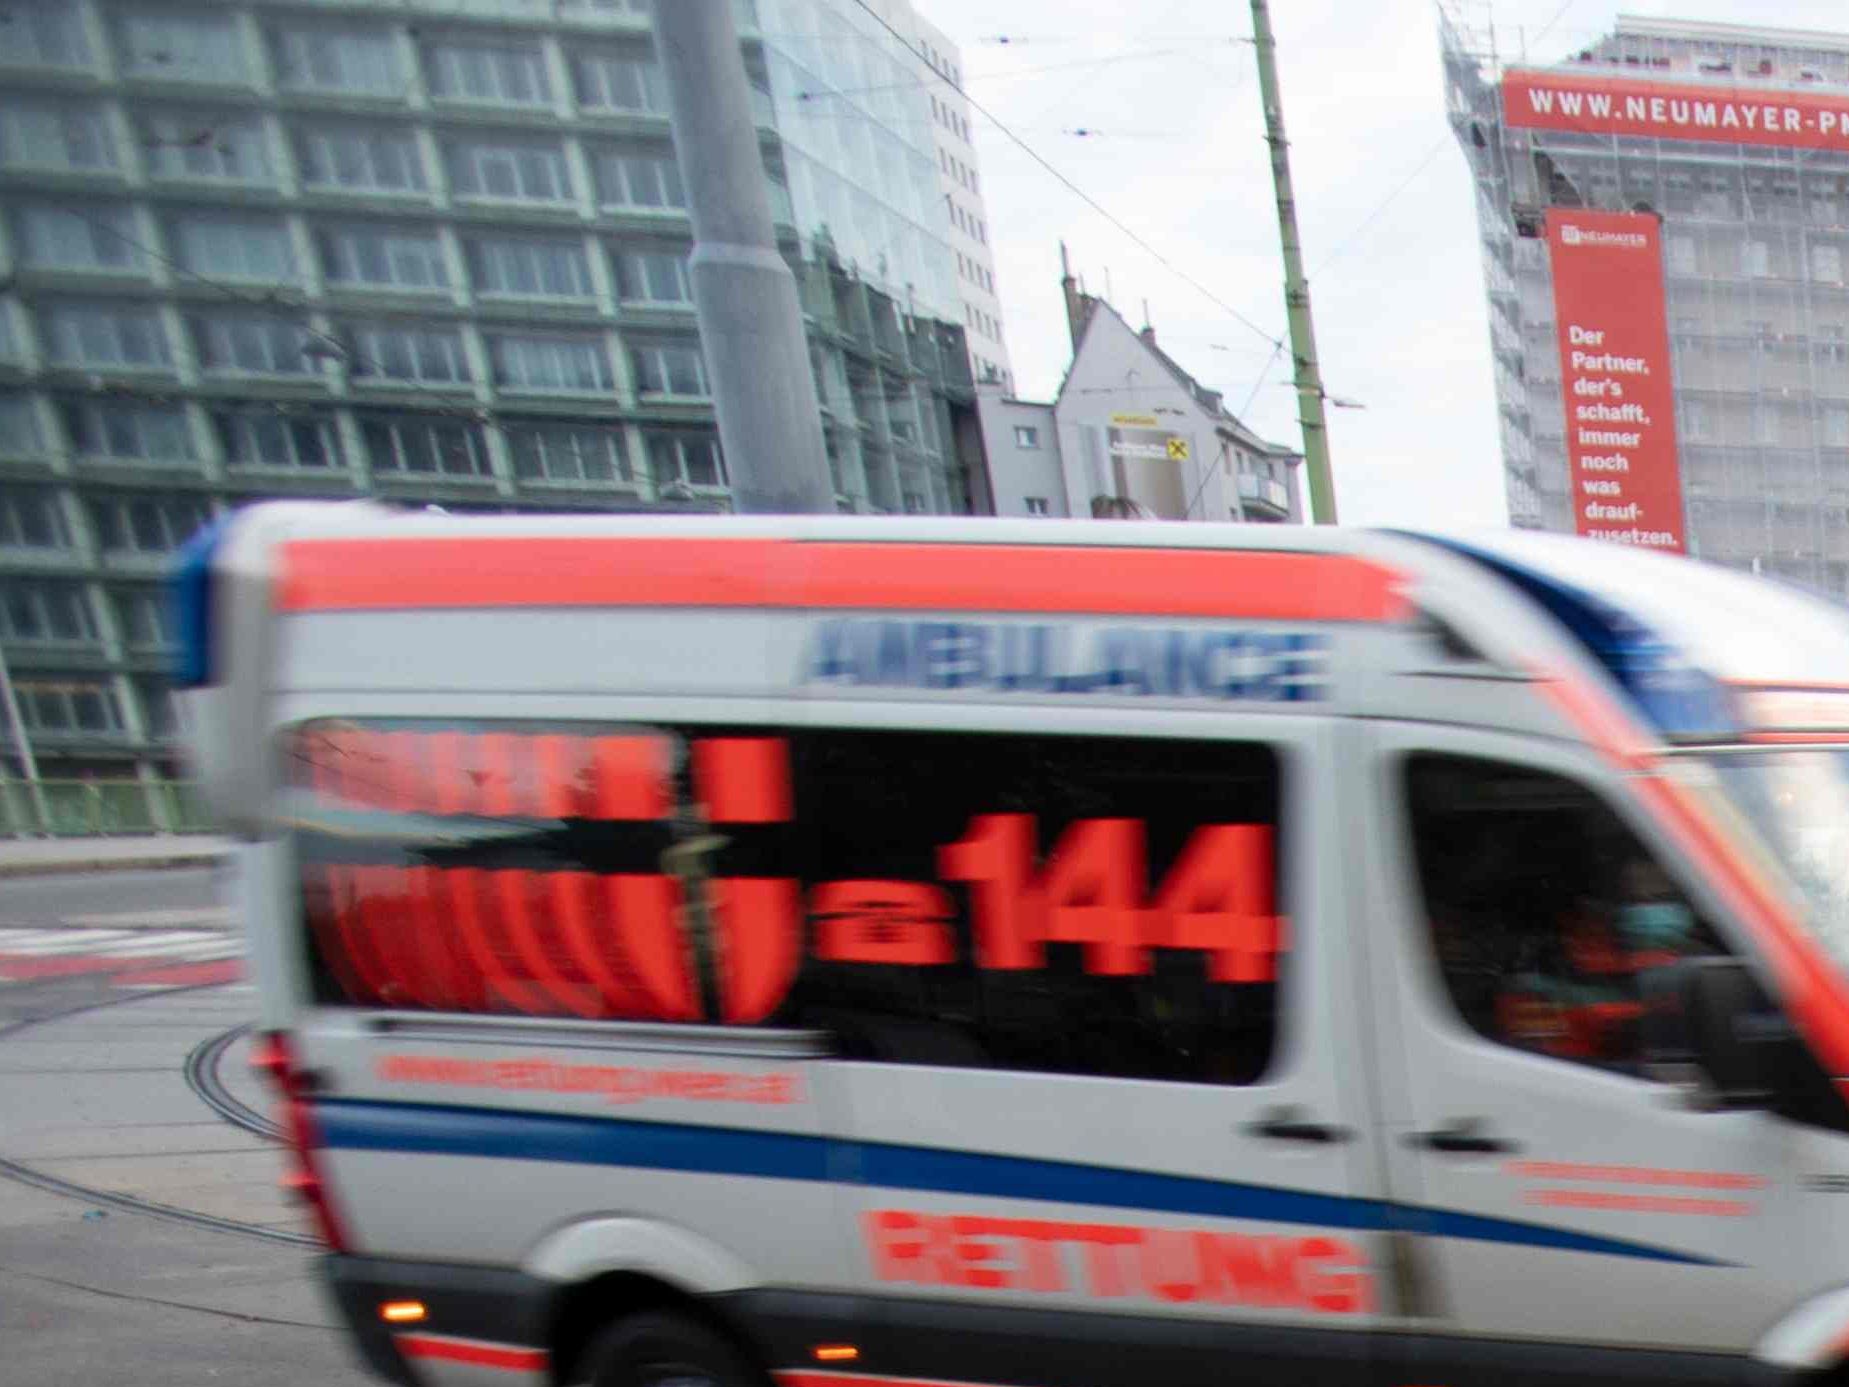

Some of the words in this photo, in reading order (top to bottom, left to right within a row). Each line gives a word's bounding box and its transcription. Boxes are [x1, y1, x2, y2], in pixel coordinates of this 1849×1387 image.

[1568, 324, 1604, 345] Der
[1570, 350, 1650, 376] Partner,
[1573, 377, 1623, 397] der's
[1576, 402, 1651, 425] schafft,
[1578, 427, 1641, 448] immer
[1581, 452, 1630, 472] noch
[1582, 480, 1622, 497] was
[1585, 500, 1644, 520] drauf-
[805, 615, 1338, 703] AMBULANCE
[932, 812, 1294, 983] 144
[860, 1208, 1380, 1315] RETTUNG
